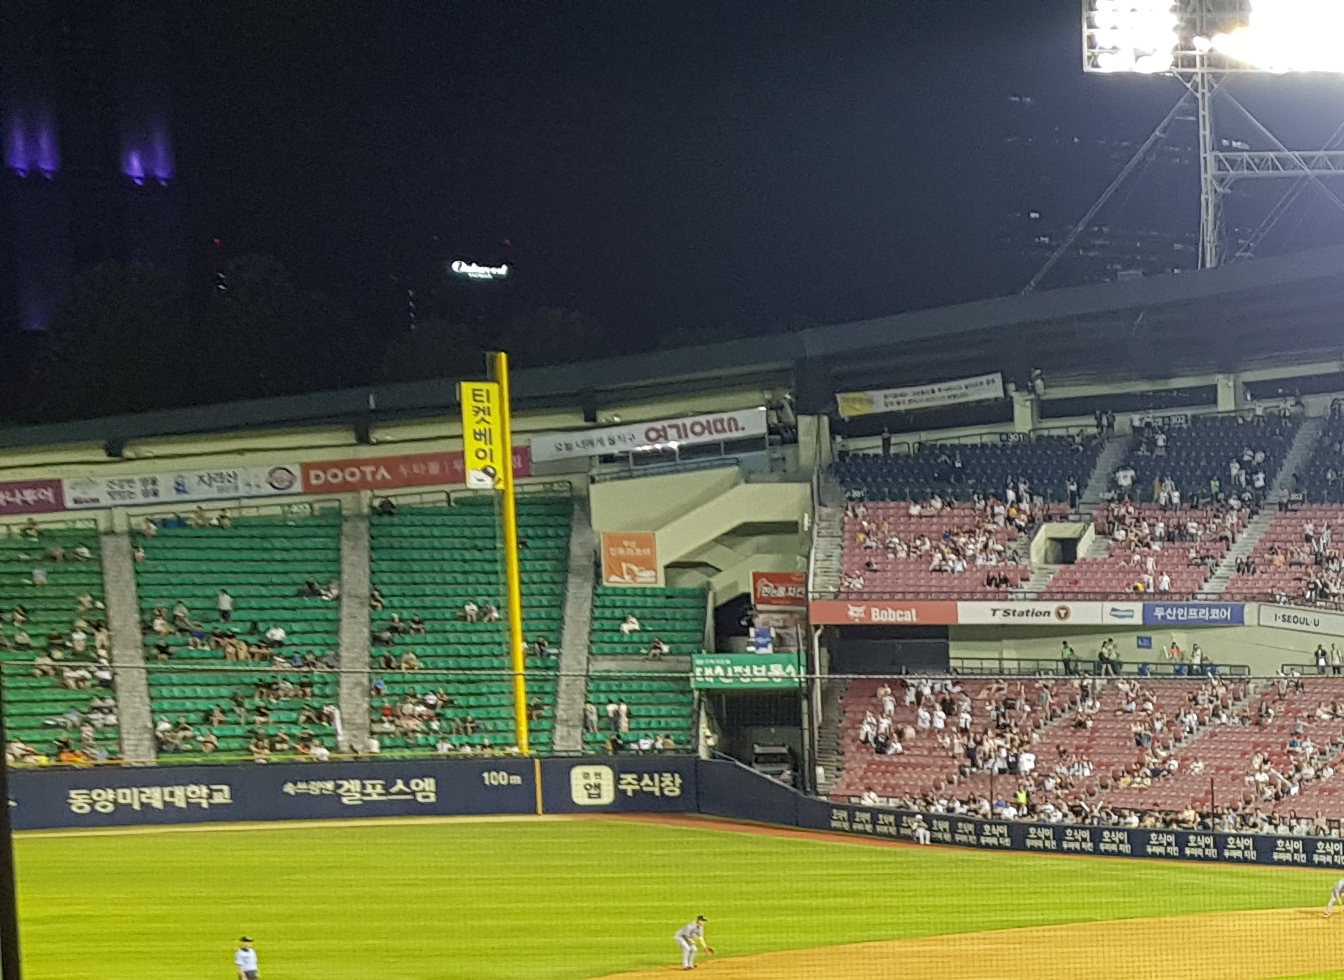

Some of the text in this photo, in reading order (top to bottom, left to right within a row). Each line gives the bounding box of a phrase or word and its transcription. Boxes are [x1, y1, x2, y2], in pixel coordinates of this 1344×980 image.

[472, 387, 494, 463] 티켓베이
[308, 465, 392, 486] DOOTA
[871, 608, 917, 622] Bobcat
[1154, 606, 1231, 621] 두산인프라코어
[482, 771, 522, 786] 100m
[618, 772, 682, 797] 주식창
[67, 784, 233, 814] 동양미래대학교
[336, 778, 437, 806] 겔포스엠
[1276, 839, 1302, 853] 호식이
[1316, 841, 1343, 855] 호식이
